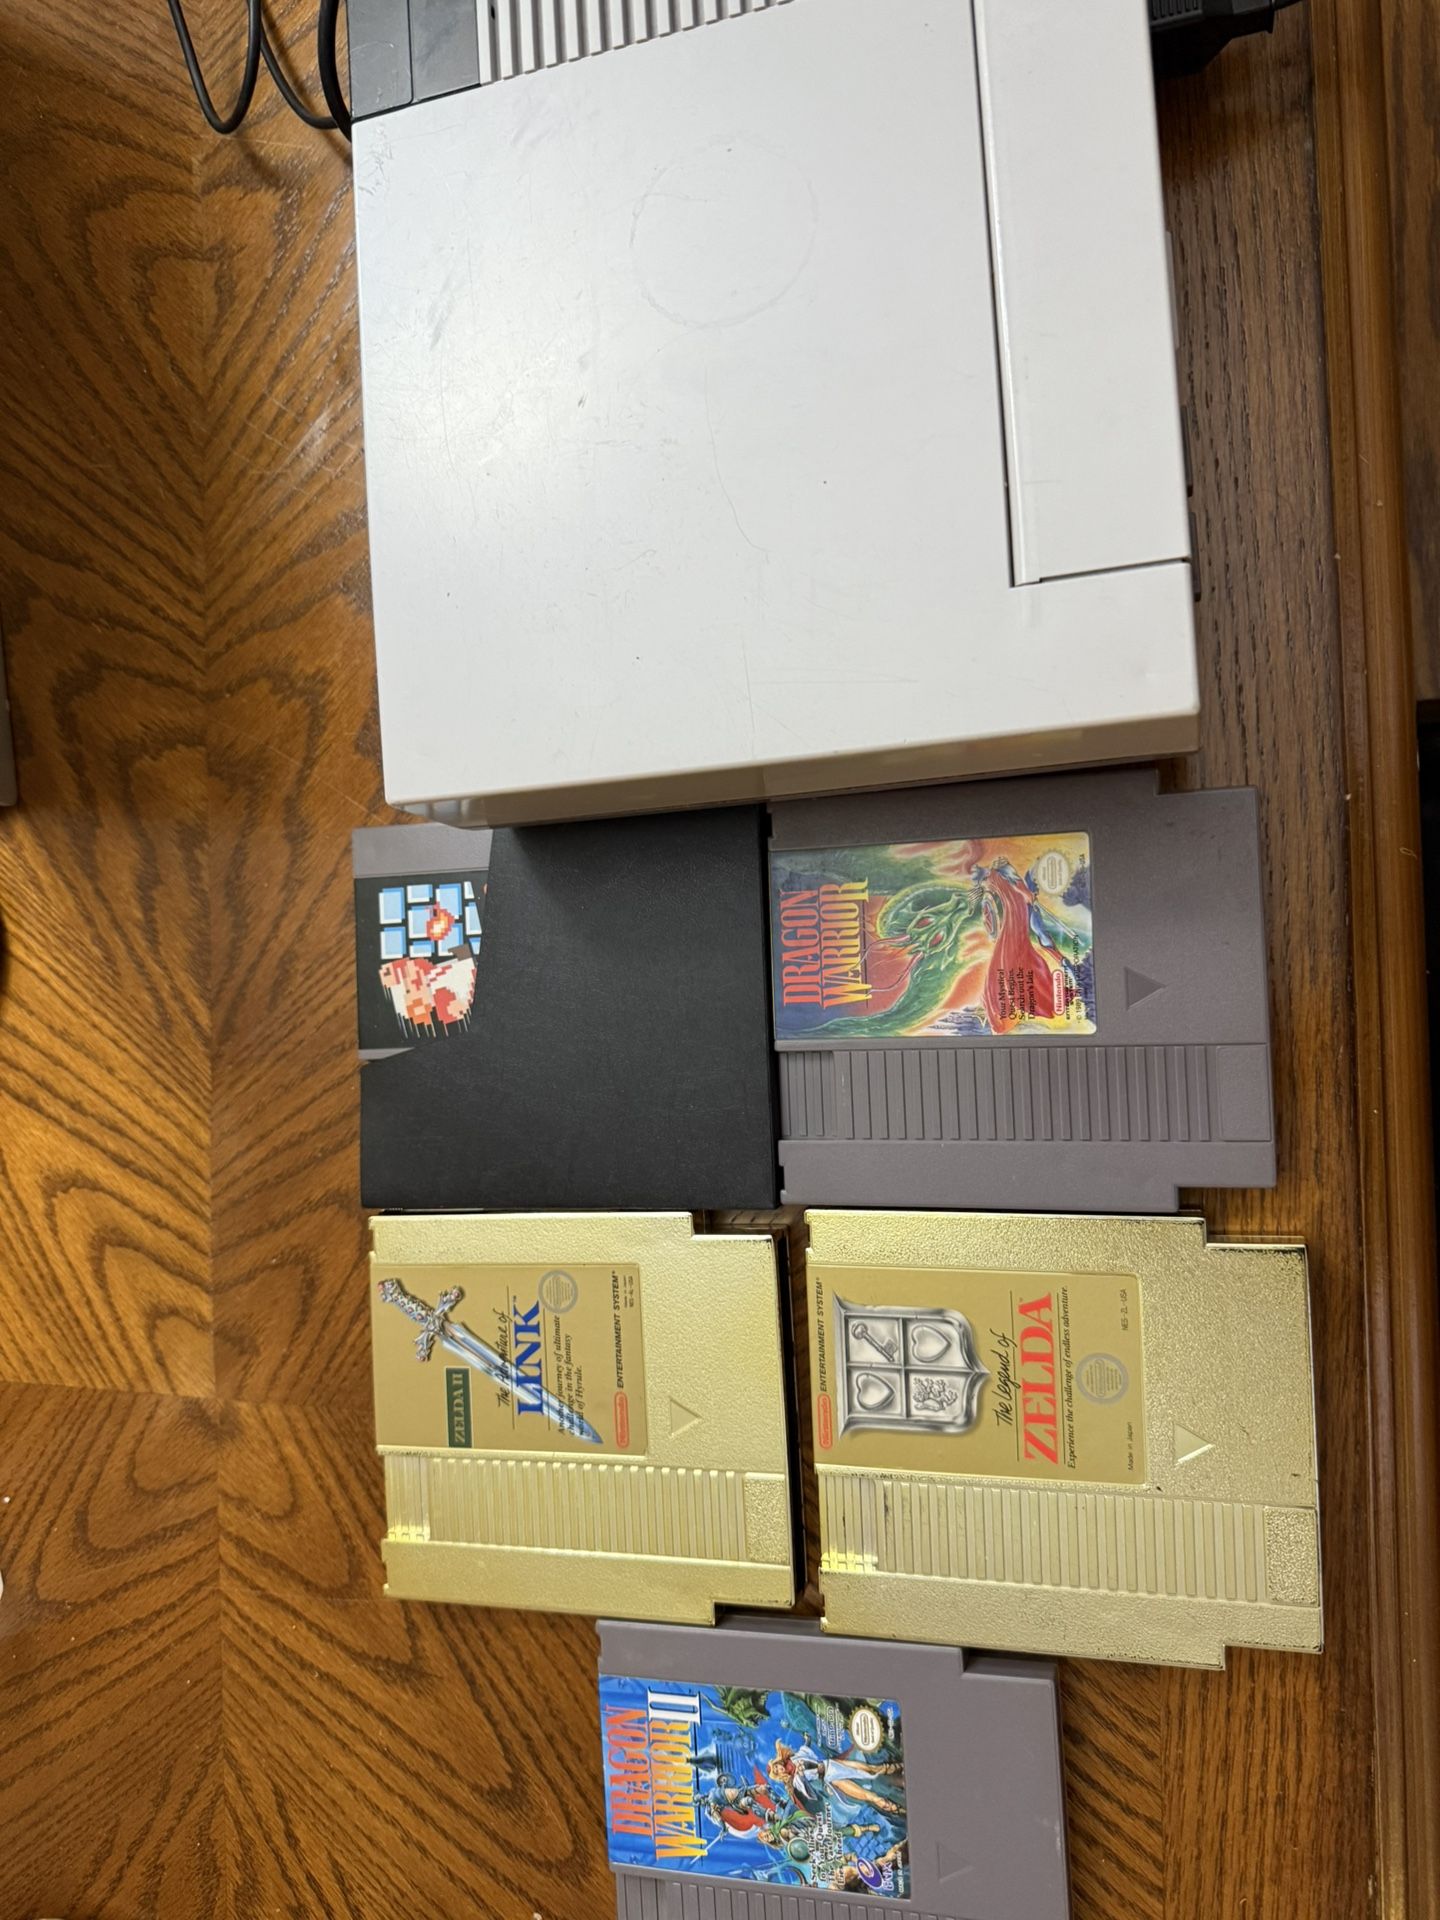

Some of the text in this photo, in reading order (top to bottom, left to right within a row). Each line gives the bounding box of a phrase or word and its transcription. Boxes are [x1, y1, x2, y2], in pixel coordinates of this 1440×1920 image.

[780, 889, 822, 1007] DRAGON
[819, 877, 872, 1009] WARRIOR
[997, 969, 1007, 1000] Mystical
[1055, 973, 1063, 1011] Nintendo
[1028, 986, 1036, 1019] Dragon's
[553, 1315, 561, 1350] ultimate
[563, 1334, 573, 1366] fantasy
[1062, 1329, 1071, 1358] endless
[492, 1308, 512, 1408] The Adventure of
[512, 1301, 544, 1415] LINK
[554, 1352, 563, 1362] of
[614, 1313, 623, 1388] ENTERTAINMENT
[818, 1319, 827, 1392] ENTERTAINMENT
[1062, 1358, 1074, 1368] of
[555, 1366, 564, 1397] journey
[564, 1368, 572, 1381] the
[566, 1383, 572, 1391] in
[575, 1366, 583, 1397] Hyrule.
[990, 1328, 1021, 1426] The Legend of
[1018, 1292, 1058, 1464] ZELDA
[1064, 1368, 1073, 1408] challenge
[452, 1373, 465, 1443] ZELDA II
[576, 1399, 585, 1409] of
[1066, 1409, 1074, 1422] the
[1067, 1425, 1076, 1468] Experience
[605, 1703, 654, 1840] DRAGON
[647, 1686, 708, 1860] WARRIOR II
[815, 1812, 824, 1840] Quest
[835, 1832, 843, 1860] Ahead
